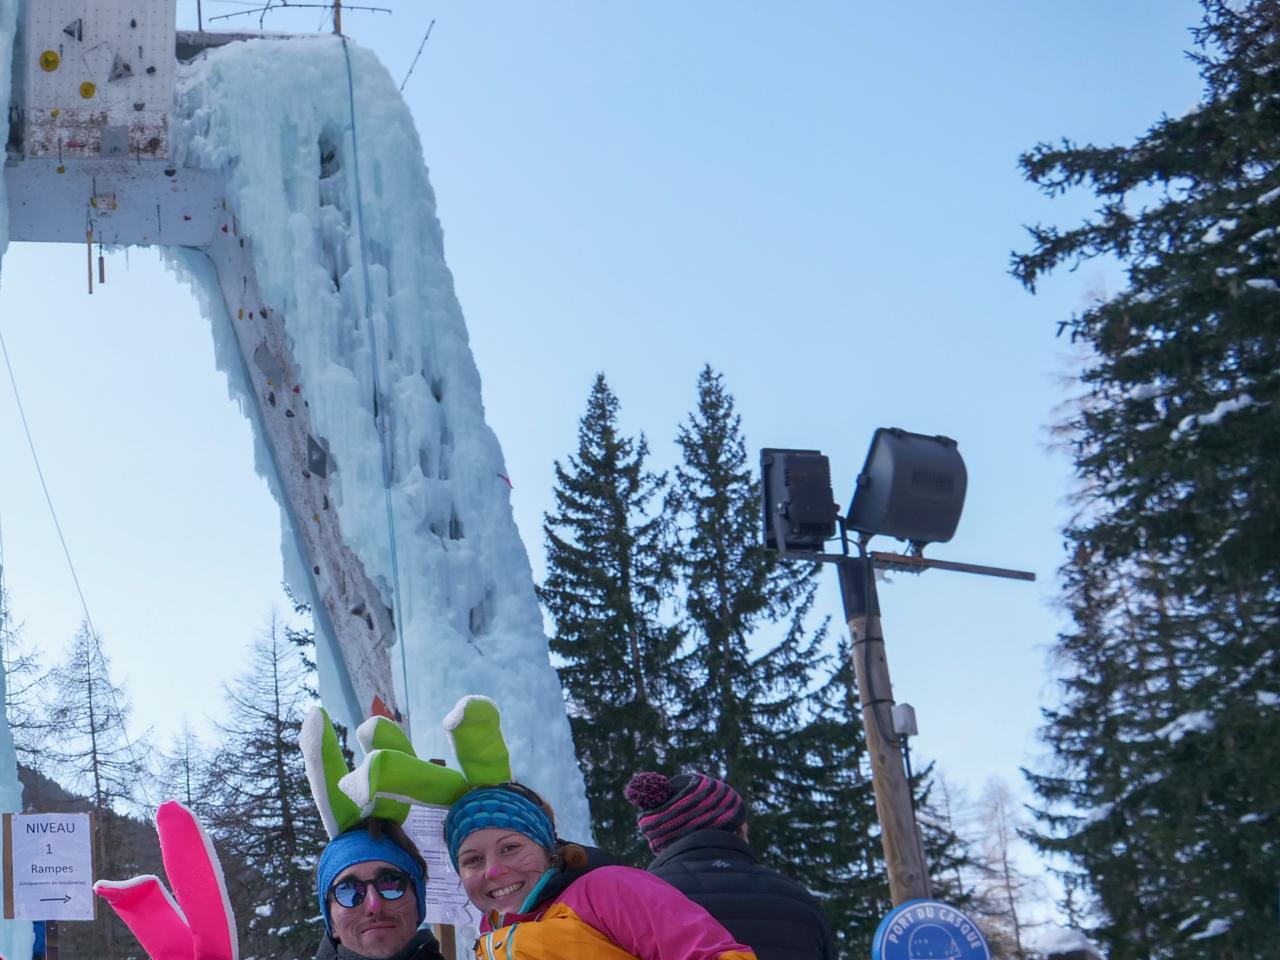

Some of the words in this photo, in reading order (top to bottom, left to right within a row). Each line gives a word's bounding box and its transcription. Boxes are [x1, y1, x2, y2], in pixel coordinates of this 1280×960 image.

[26, 822, 75, 834] NIVEAU
[46, 843, 53, 855] 1
[31, 864, 74, 875] Rampes
[888, 912, 915, 944] PORT
[917, 907, 935, 920] DU
[939, 908, 982, 949] CASQUE
